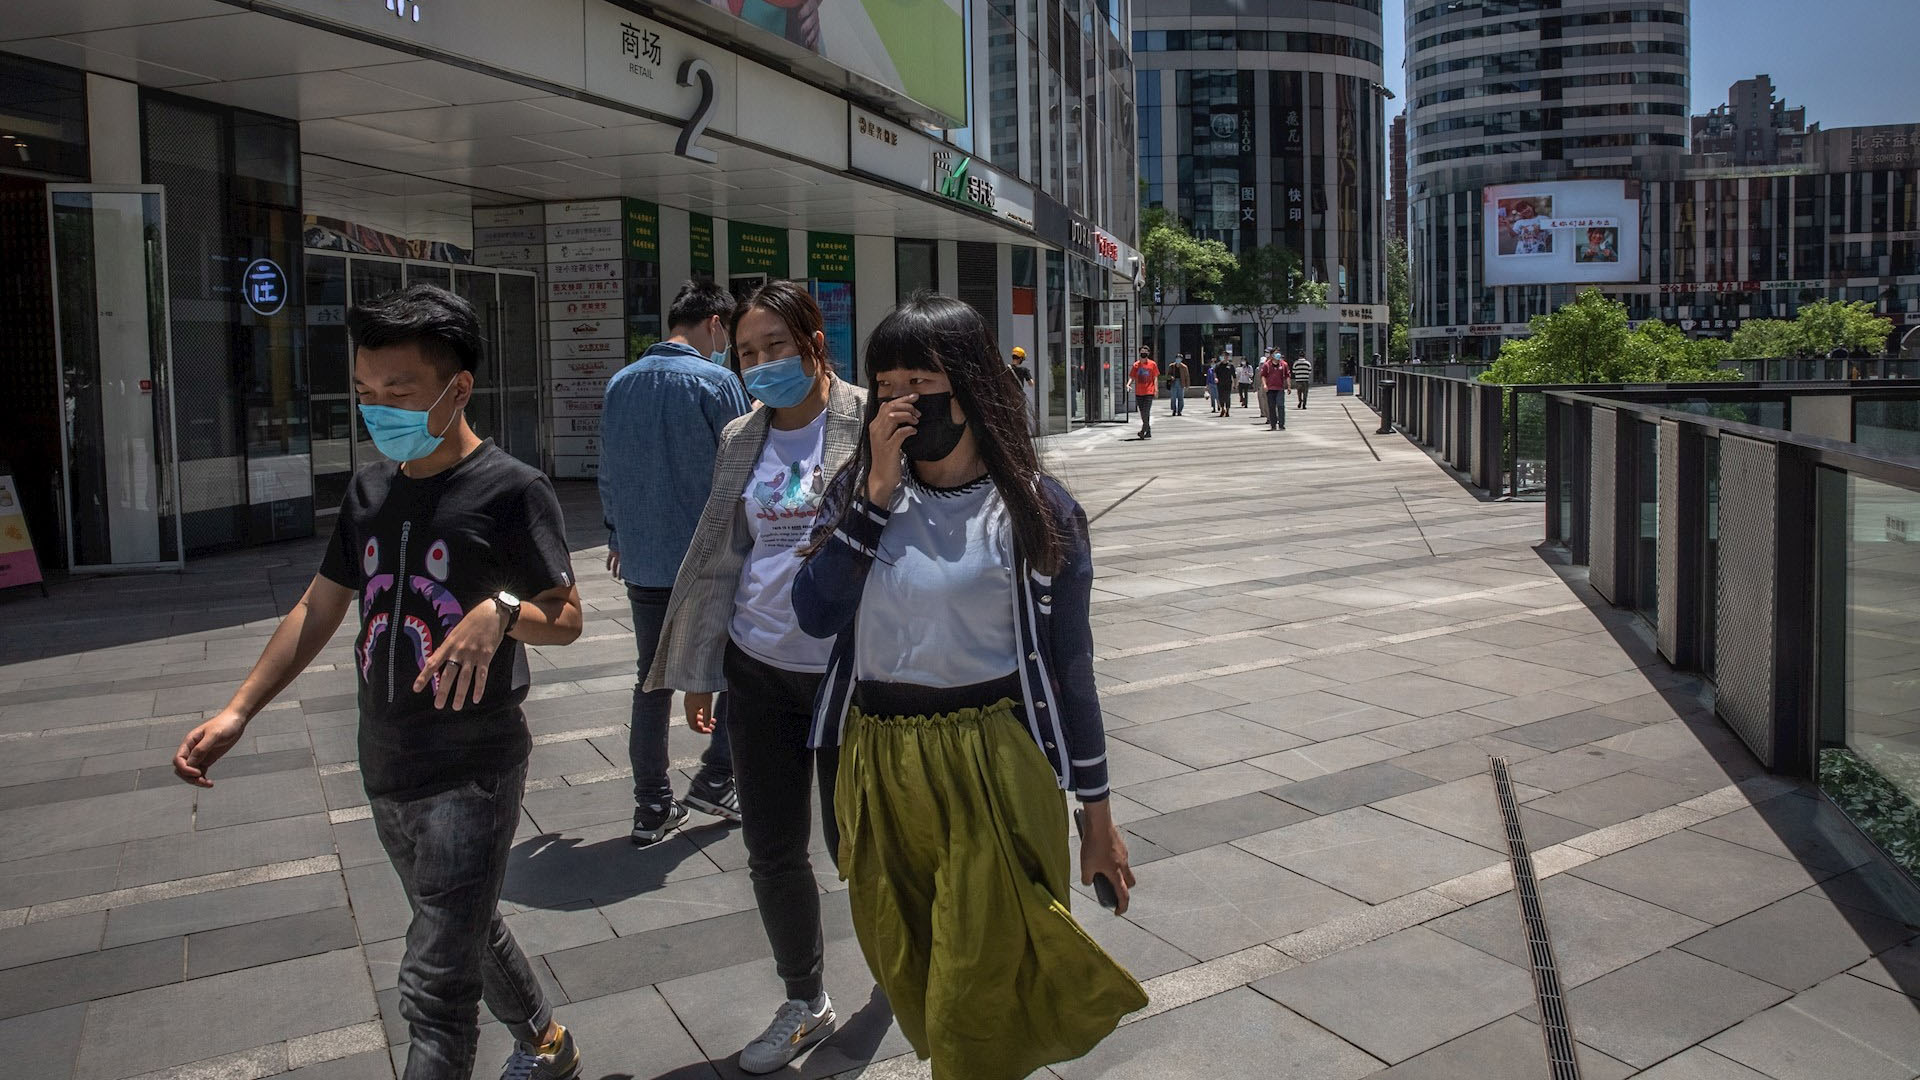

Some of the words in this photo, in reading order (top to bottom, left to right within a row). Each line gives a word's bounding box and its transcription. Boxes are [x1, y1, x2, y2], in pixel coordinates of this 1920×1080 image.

[620, 22, 662, 66] 商场
[629, 62, 654, 80] RETAIL
[675, 58, 720, 164] 2
[1241, 110, 1252, 152] TATTOO
[1241, 186, 1255, 222] 图文
[1288, 187, 1302, 222] 快印
